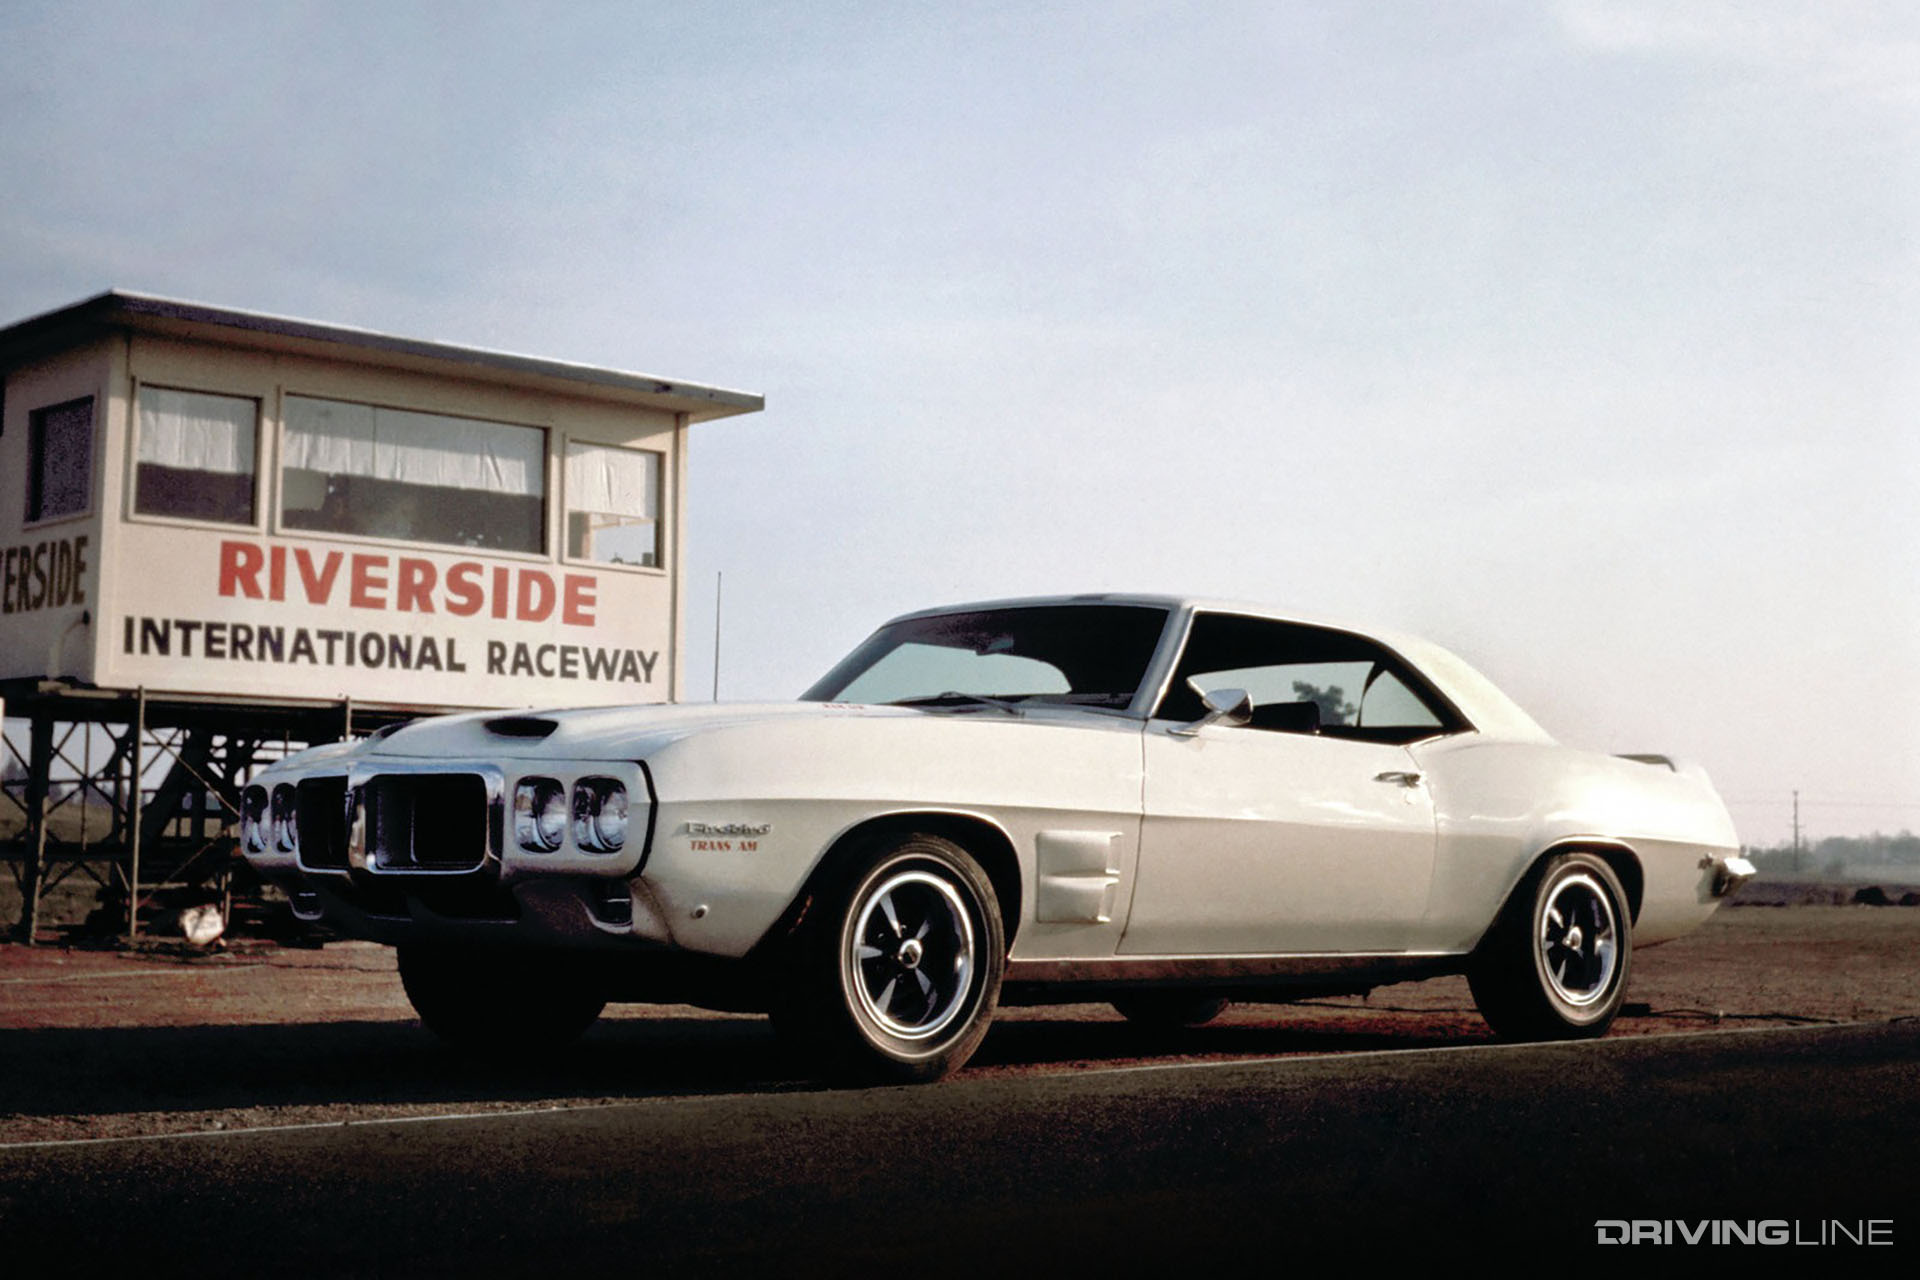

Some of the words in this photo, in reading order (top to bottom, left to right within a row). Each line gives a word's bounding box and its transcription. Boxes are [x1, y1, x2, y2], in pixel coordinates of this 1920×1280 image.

[0, 535, 88, 614] ERSIDE
[218, 540, 598, 627] RIVERSIDE
[123, 615, 466, 673] INTERNATIONAL
[486, 639, 659, 684] RACEWAY
[690, 840, 731, 852] TRANS
[739, 841, 758, 852] AM
